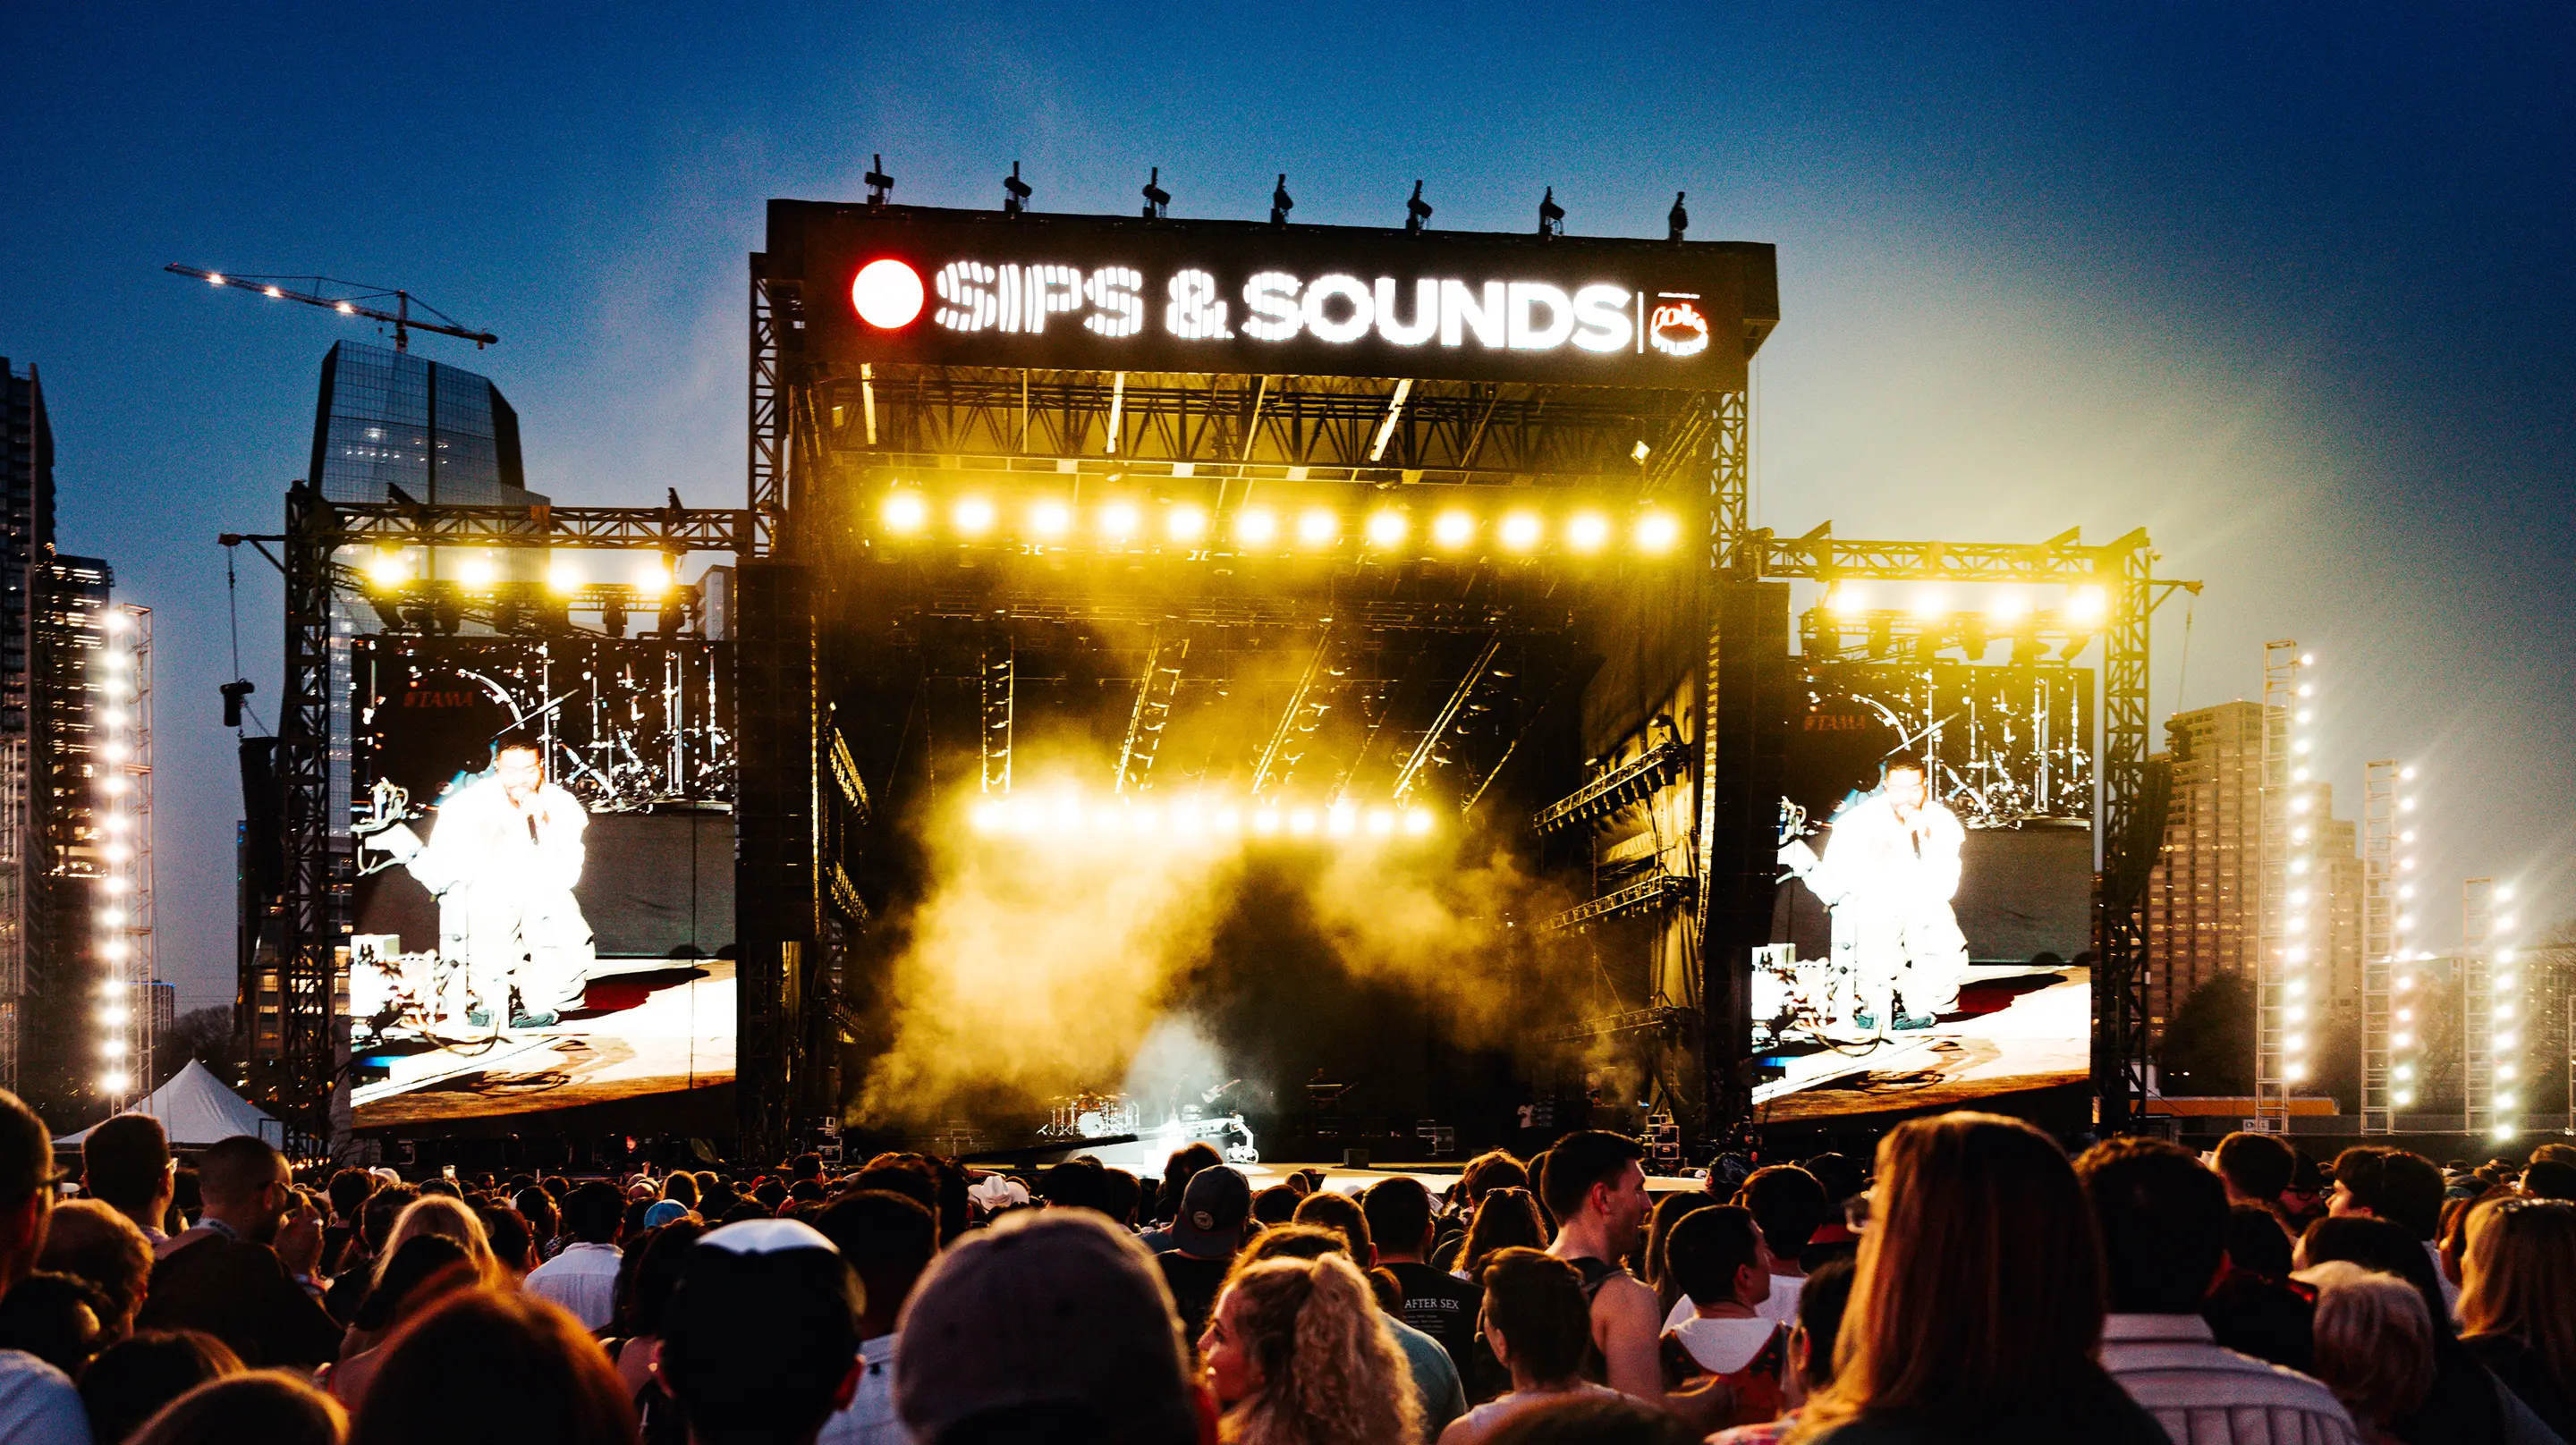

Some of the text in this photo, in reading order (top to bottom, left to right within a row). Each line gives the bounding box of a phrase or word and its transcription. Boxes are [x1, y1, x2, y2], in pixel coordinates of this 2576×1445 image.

[935, 260, 1633, 357] SIPS & SOUNDS
[419, 691, 474, 708] TAMA
[1404, 1298, 1460, 1310] AFTER SEX
